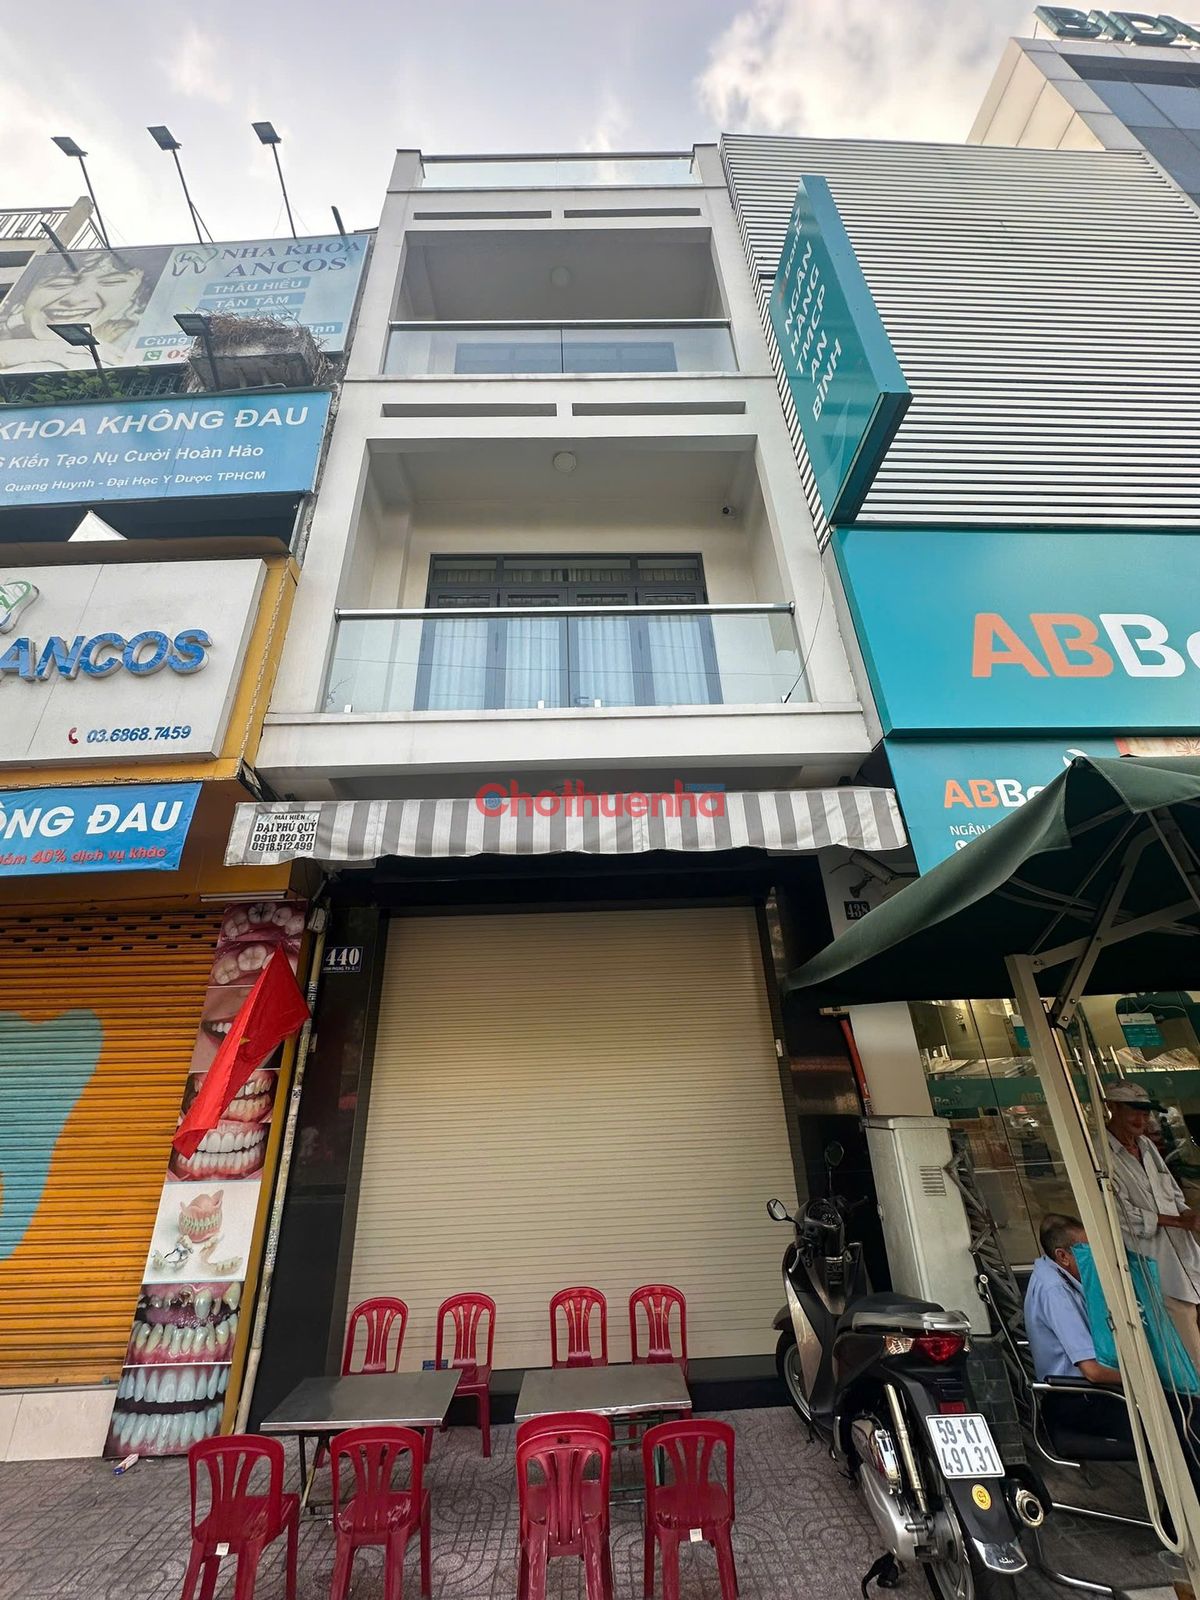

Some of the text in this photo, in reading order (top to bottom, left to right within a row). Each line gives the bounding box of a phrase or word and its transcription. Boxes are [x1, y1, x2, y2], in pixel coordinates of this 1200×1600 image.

[221, 241, 361, 260] NHA KHOA
[224, 256, 349, 278] ANCOS
[254, 294, 289, 306] TÂM
[796, 284, 825, 375] TMCP
[811, 329, 828, 384] AN
[0, 406, 309, 440] KHOA KHÔNG ĐAU
[8, 452, 49, 469] Kiến
[56, 453, 88, 468] Tạo
[92, 451, 119, 466] Nụ
[124, 446, 171, 463] Cười
[175, 445, 222, 460] Hoàn
[228, 444, 264, 458] Hảo
[4, 482, 49, 492] Quang
[51, 479, 95, 491] Huynh
[106, 476, 129, 488] Đại
[131, 475, 158, 487] Học
[163, 475, 172, 484] Y
[174, 472, 213, 484] Dược
[217, 470, 266, 482] TPHCM
[0, 628, 212, 682] ANCOS
[971, 612, 1200, 678] ABB
[86, 725, 192, 743] 03.6868.7459
[86, 800, 184, 835] ĐAU
[256, 822, 275, 834] ĐẠI
[276, 820, 296, 832] PHÚ
[253, 833, 277, 843] 0918
[949, 822, 986, 836] NGÂN
[30, 848, 67, 863] 40%
[71, 849, 105, 864] dịch
[107, 849, 126, 863] vụ
[129, 846, 168, 859] khác
[325, 948, 360, 966] 440
[940, 1445, 998, 1474] 491.31
